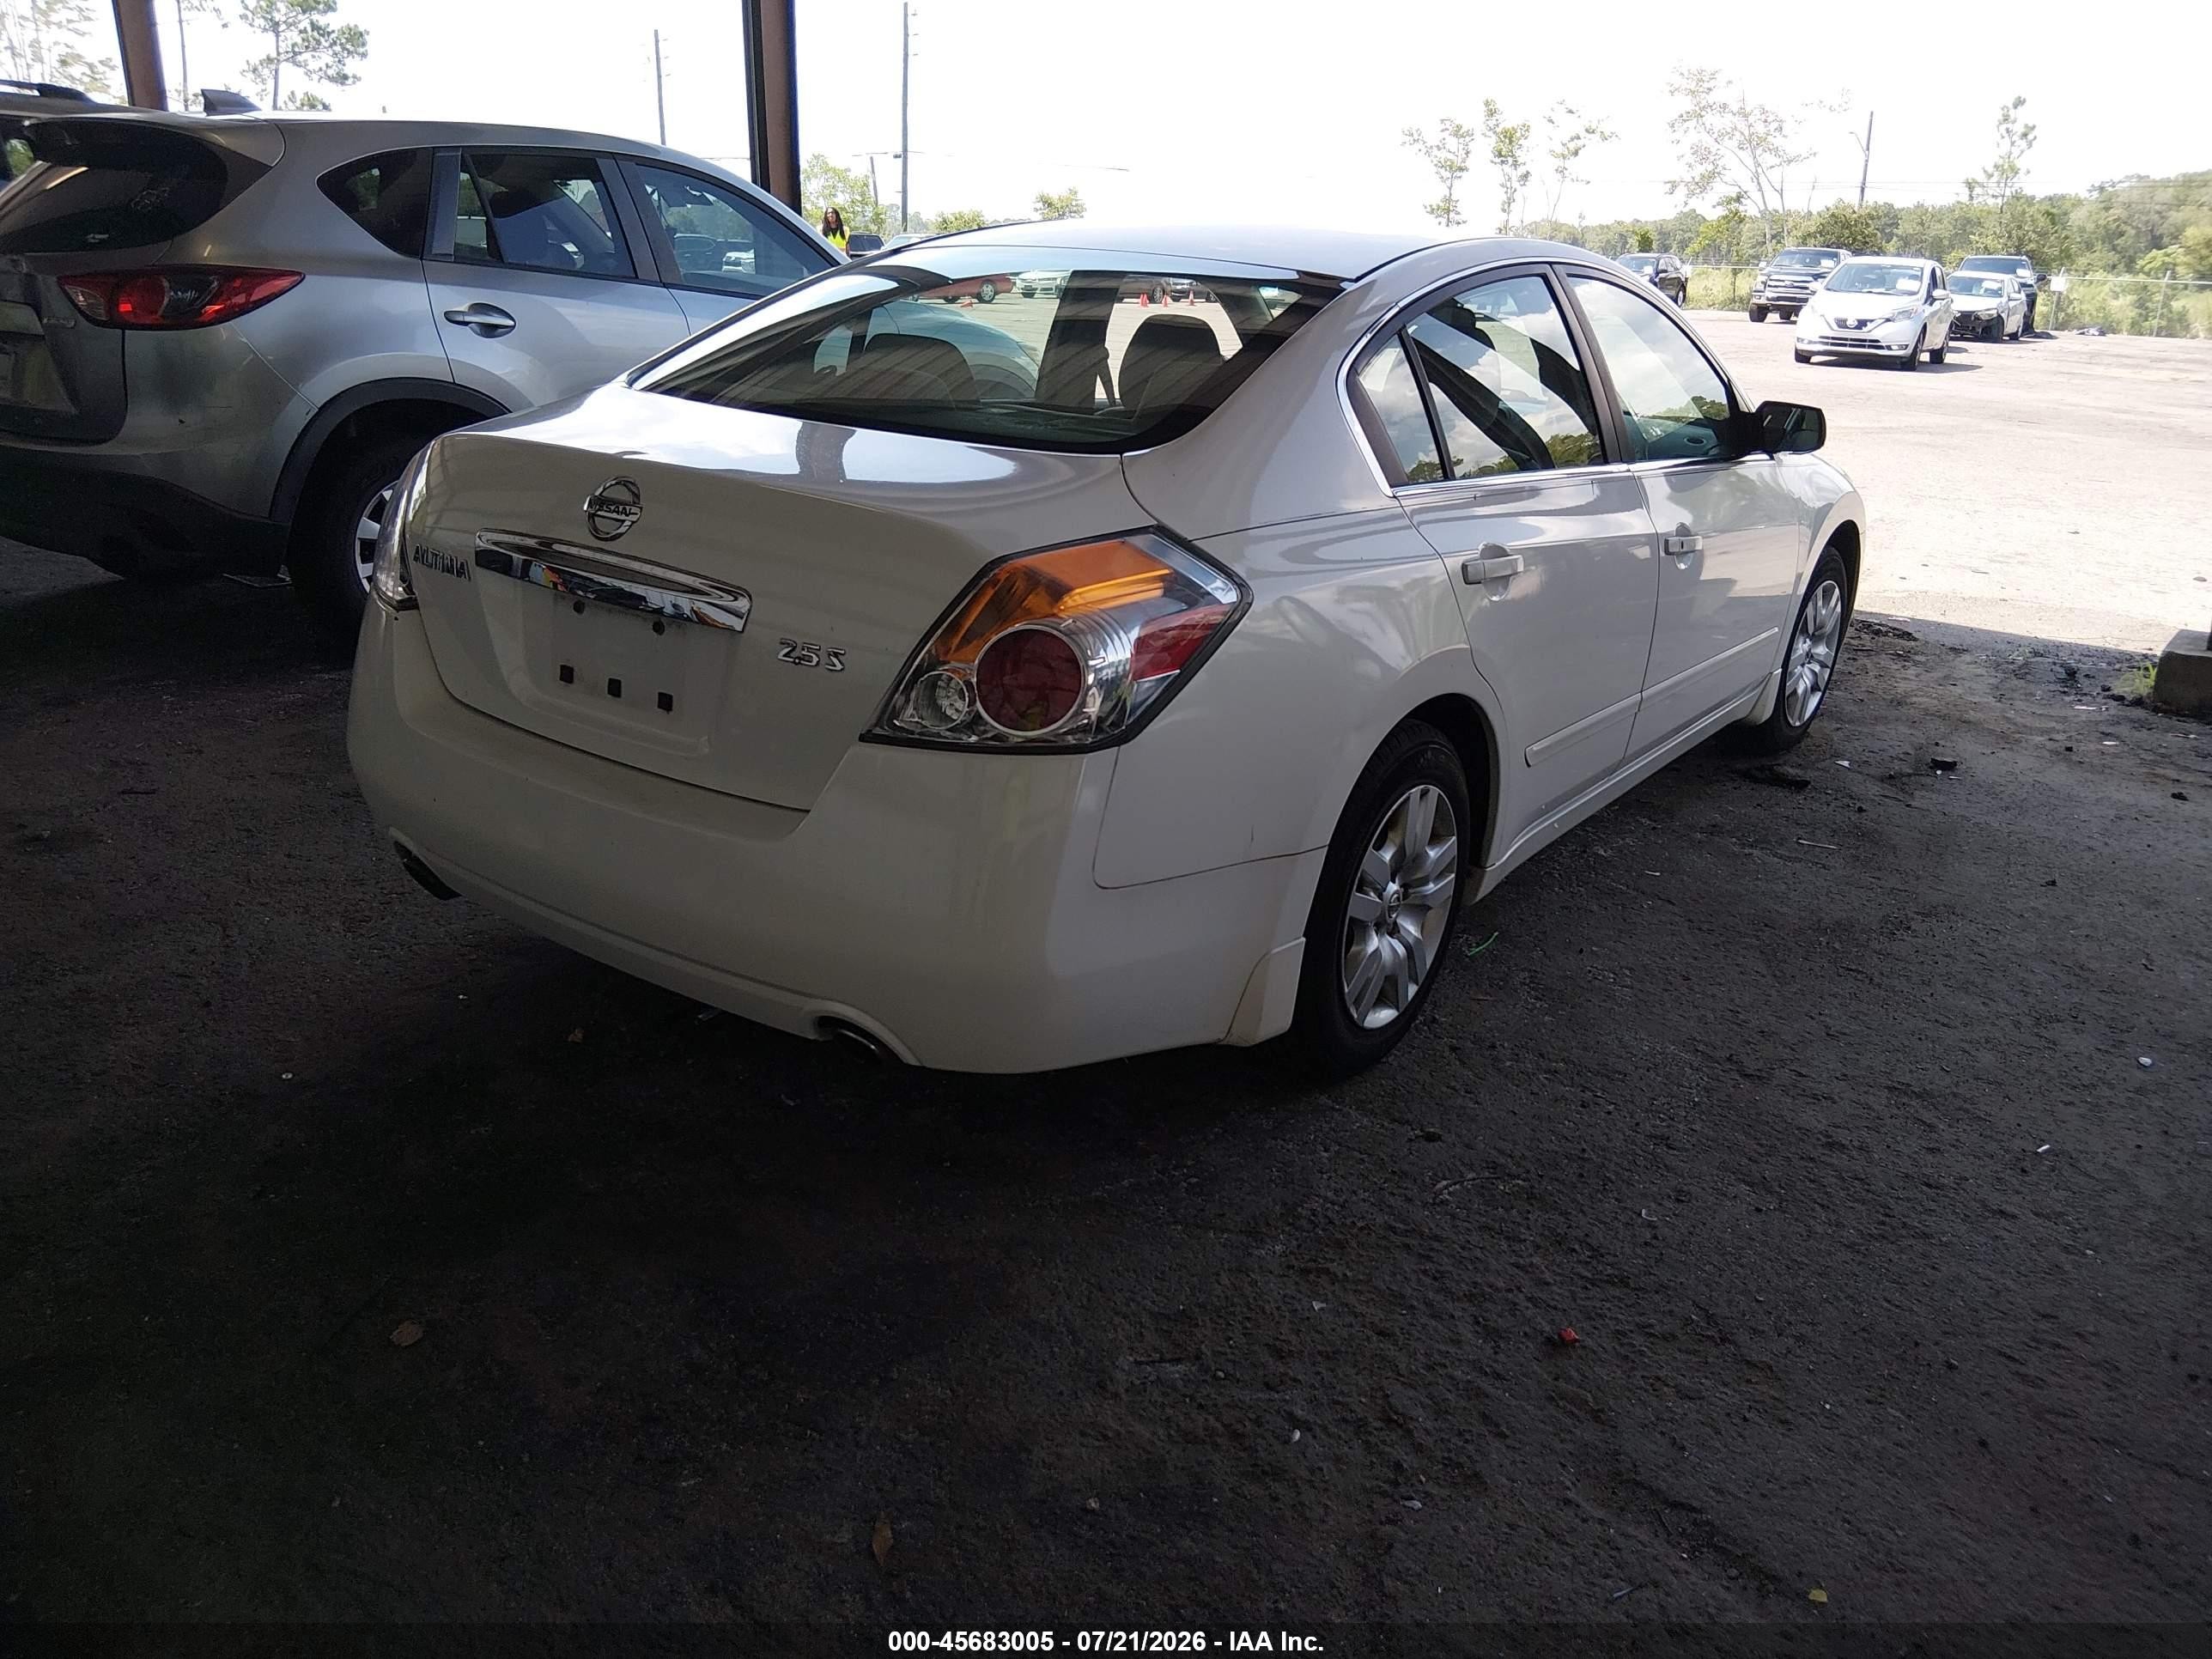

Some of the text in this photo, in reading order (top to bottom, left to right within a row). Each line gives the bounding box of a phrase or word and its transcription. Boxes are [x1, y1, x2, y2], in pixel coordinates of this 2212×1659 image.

[588, 498, 633, 517] NISSAN
[412, 544, 471, 581] ALTIMA
[824, 647, 846, 672] S
